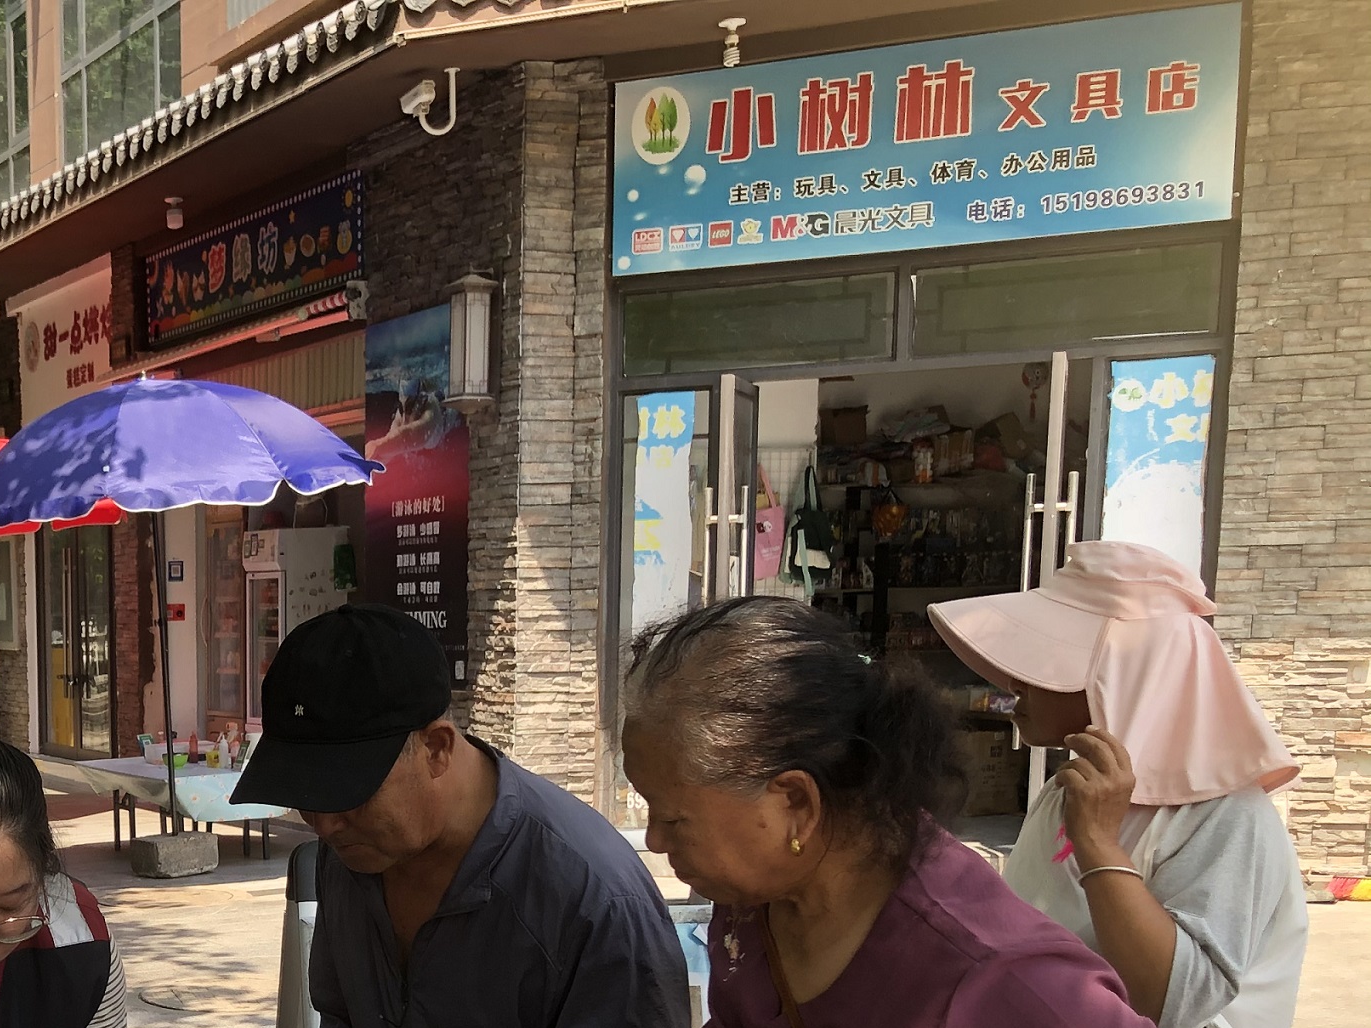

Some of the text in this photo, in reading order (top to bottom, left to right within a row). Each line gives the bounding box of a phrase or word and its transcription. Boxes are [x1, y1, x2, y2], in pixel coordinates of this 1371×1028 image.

[706, 59, 1203, 163] 小树林文具店
[730, 145, 1098, 205] 主营：玩具、文具、体育、办公用品
[711, 229, 730, 239] LEGO
[771, 213, 829, 241] M&G
[835, 202, 933, 234] 晨光文具
